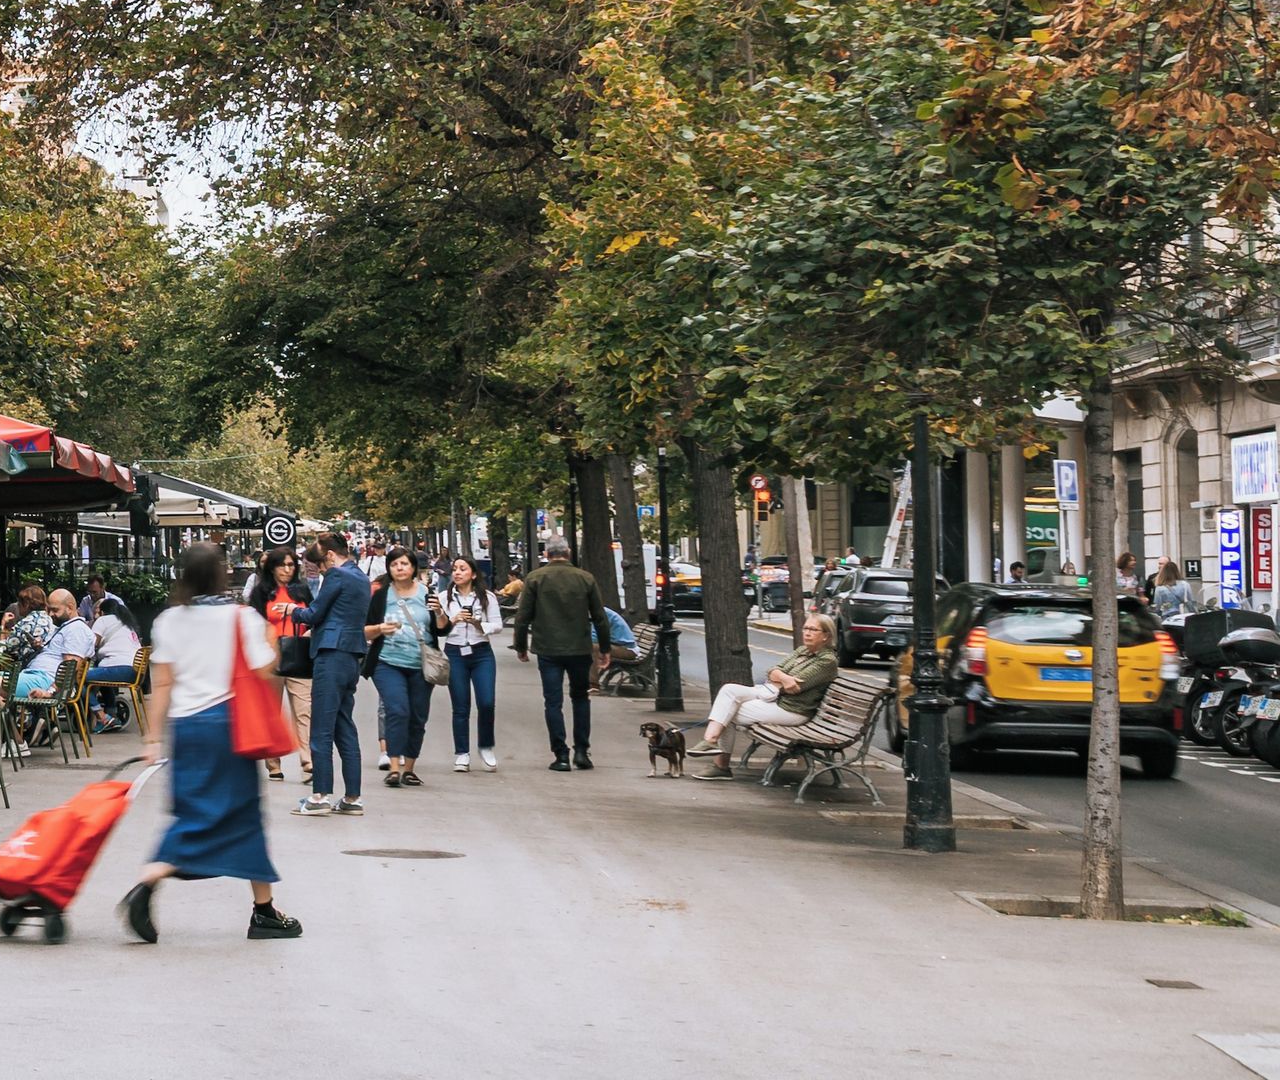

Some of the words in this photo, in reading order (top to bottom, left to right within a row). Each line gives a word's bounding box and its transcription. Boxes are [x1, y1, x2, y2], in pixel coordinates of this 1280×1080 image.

[1060, 465, 1074, 498] P
[1188, 561, 1198, 572] H
[1220, 513, 1241, 604] SUPER
[1258, 514, 1272, 585] SUPER
